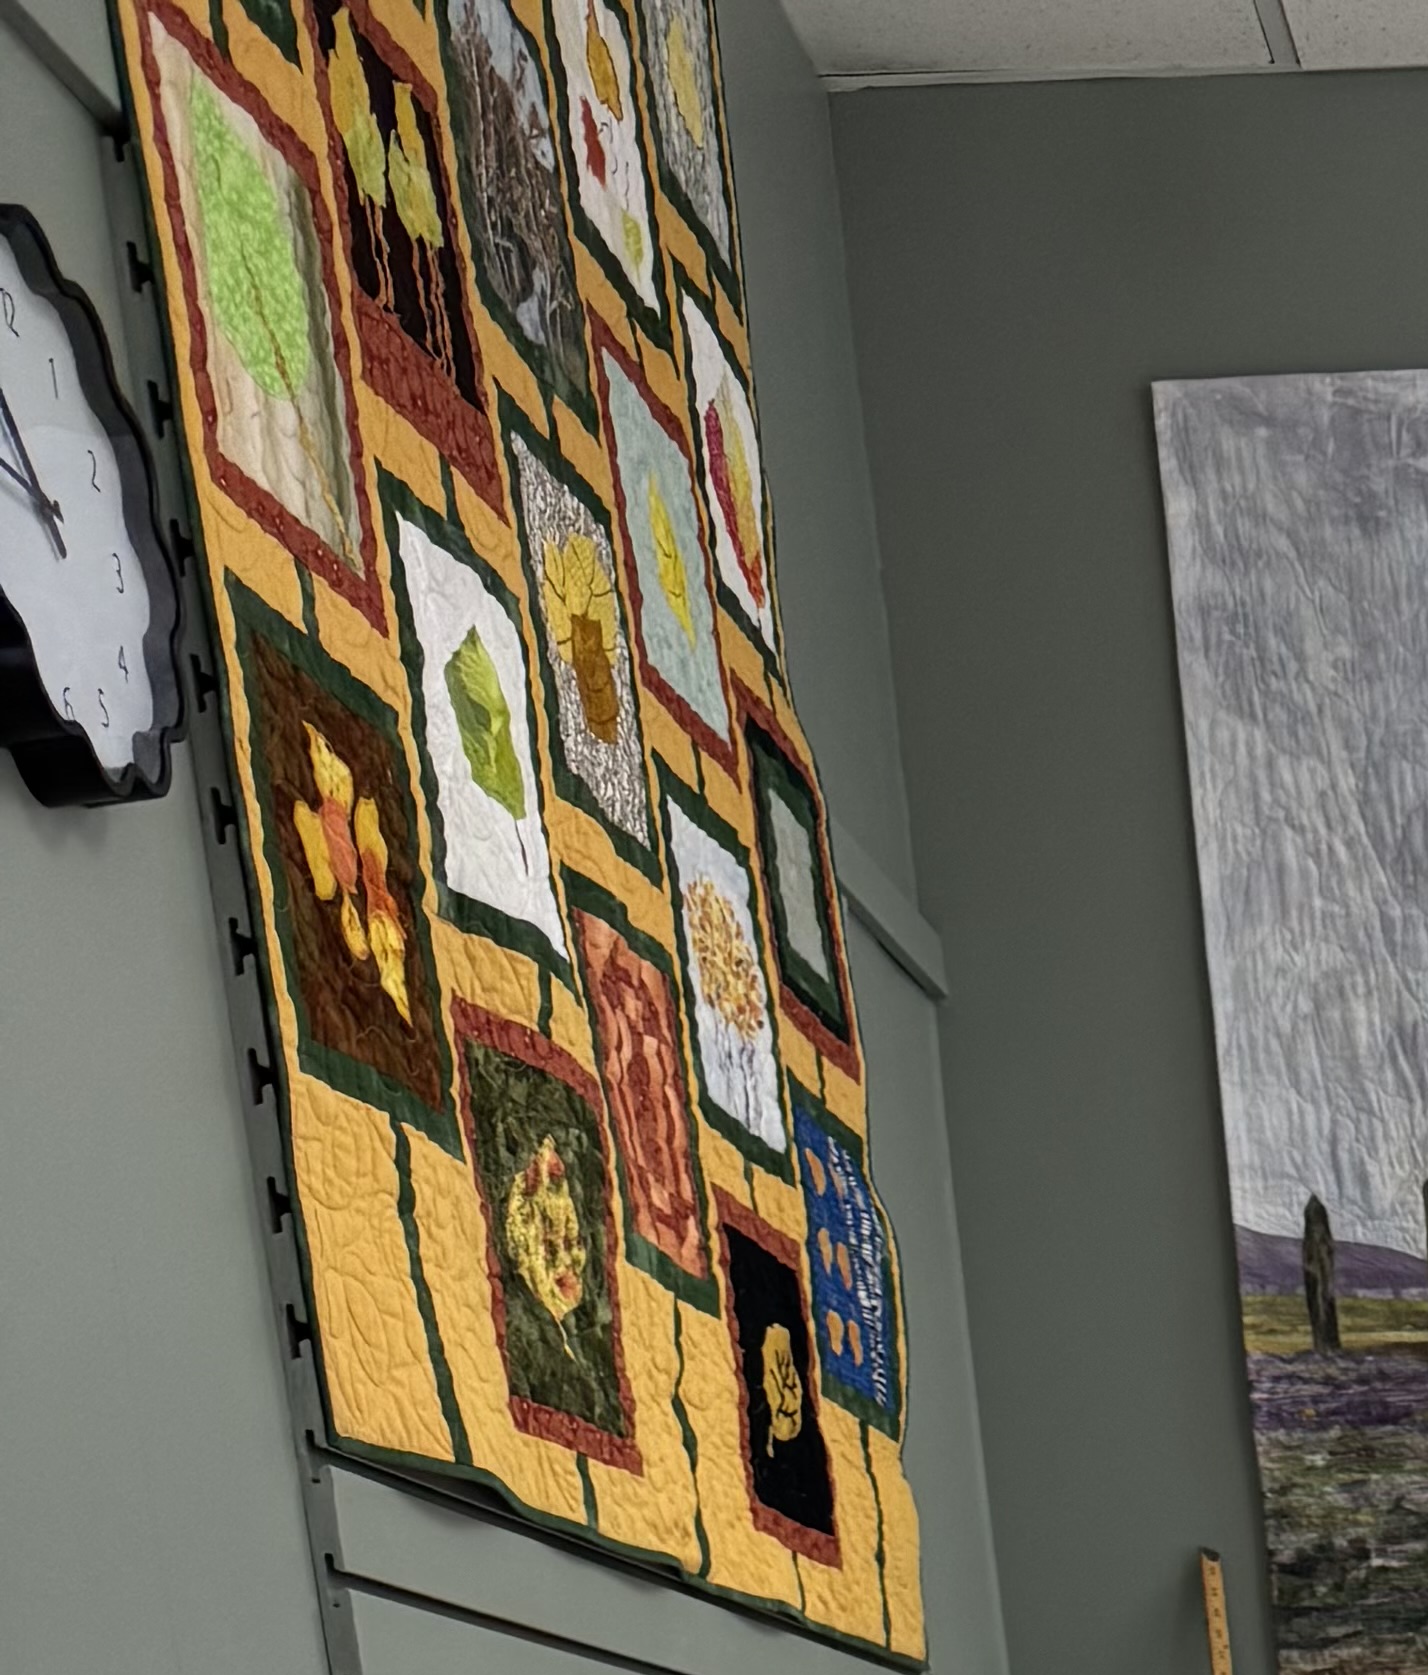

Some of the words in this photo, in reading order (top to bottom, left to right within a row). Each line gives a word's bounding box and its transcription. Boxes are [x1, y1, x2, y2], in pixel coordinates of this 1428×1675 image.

[48, 357, 59, 400] 1
[87, 449, 101, 493] 2
[110, 552, 125, 594] 3
[117, 645, 129, 684] 4
[62, 686, 77, 722] 6
[97, 687, 110, 728] 5
